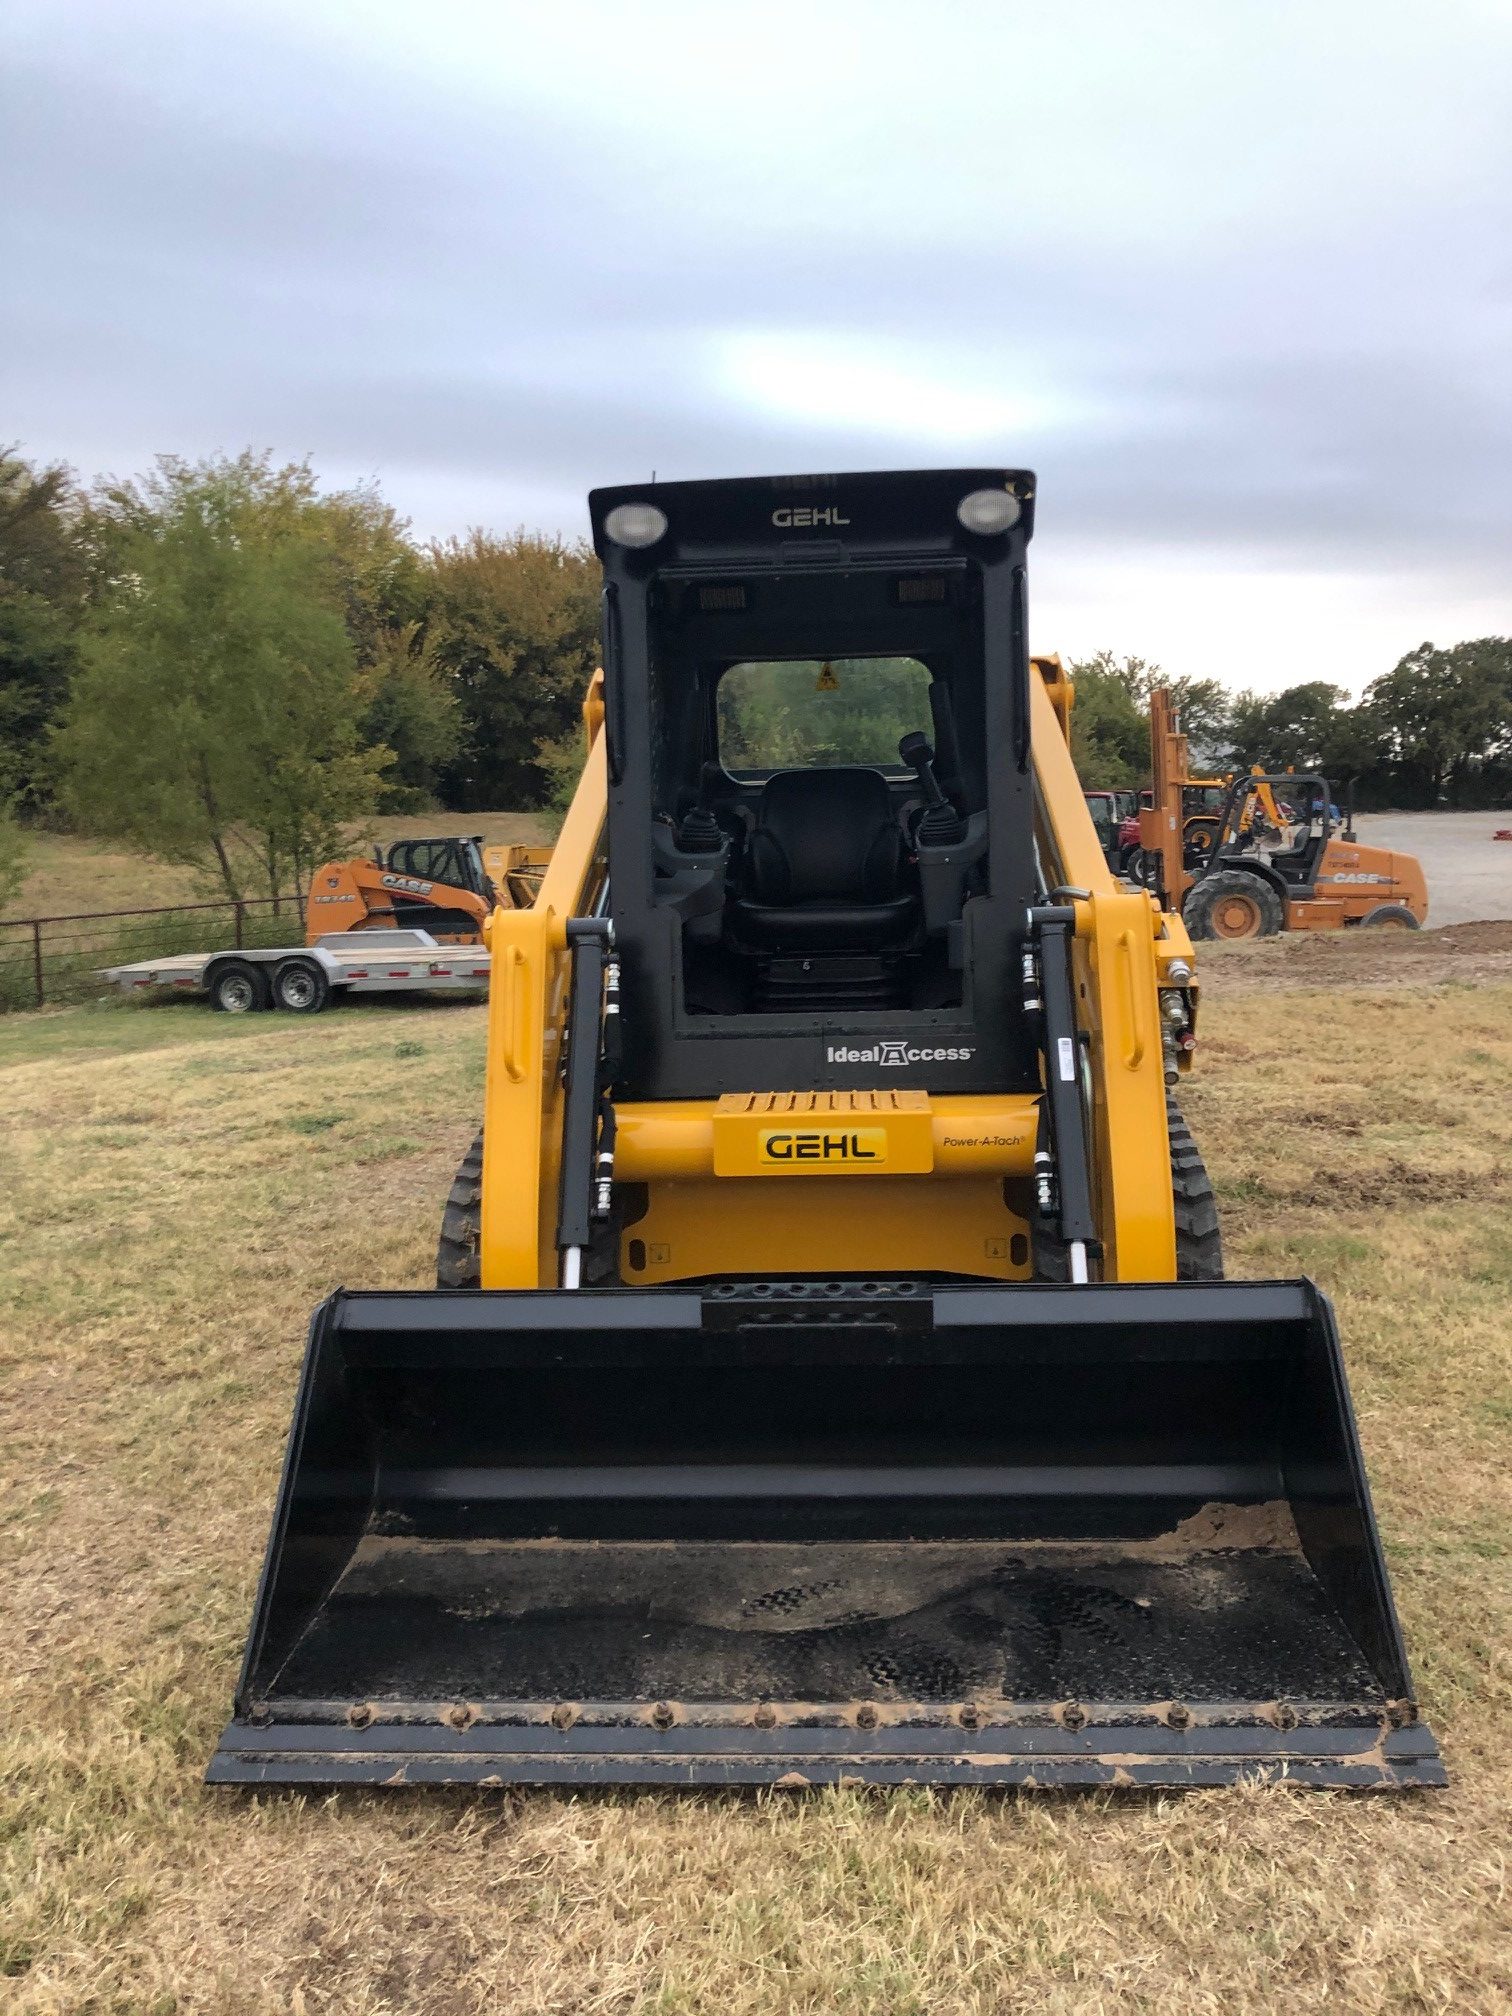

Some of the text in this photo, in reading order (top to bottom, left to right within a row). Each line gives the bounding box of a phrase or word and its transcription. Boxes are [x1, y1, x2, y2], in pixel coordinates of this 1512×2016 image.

[771, 507, 851, 527] GEHL
[382, 874, 433, 896] CASE
[1333, 872, 1379, 884] CASE
[766, 1135, 876, 1158] GEHL
